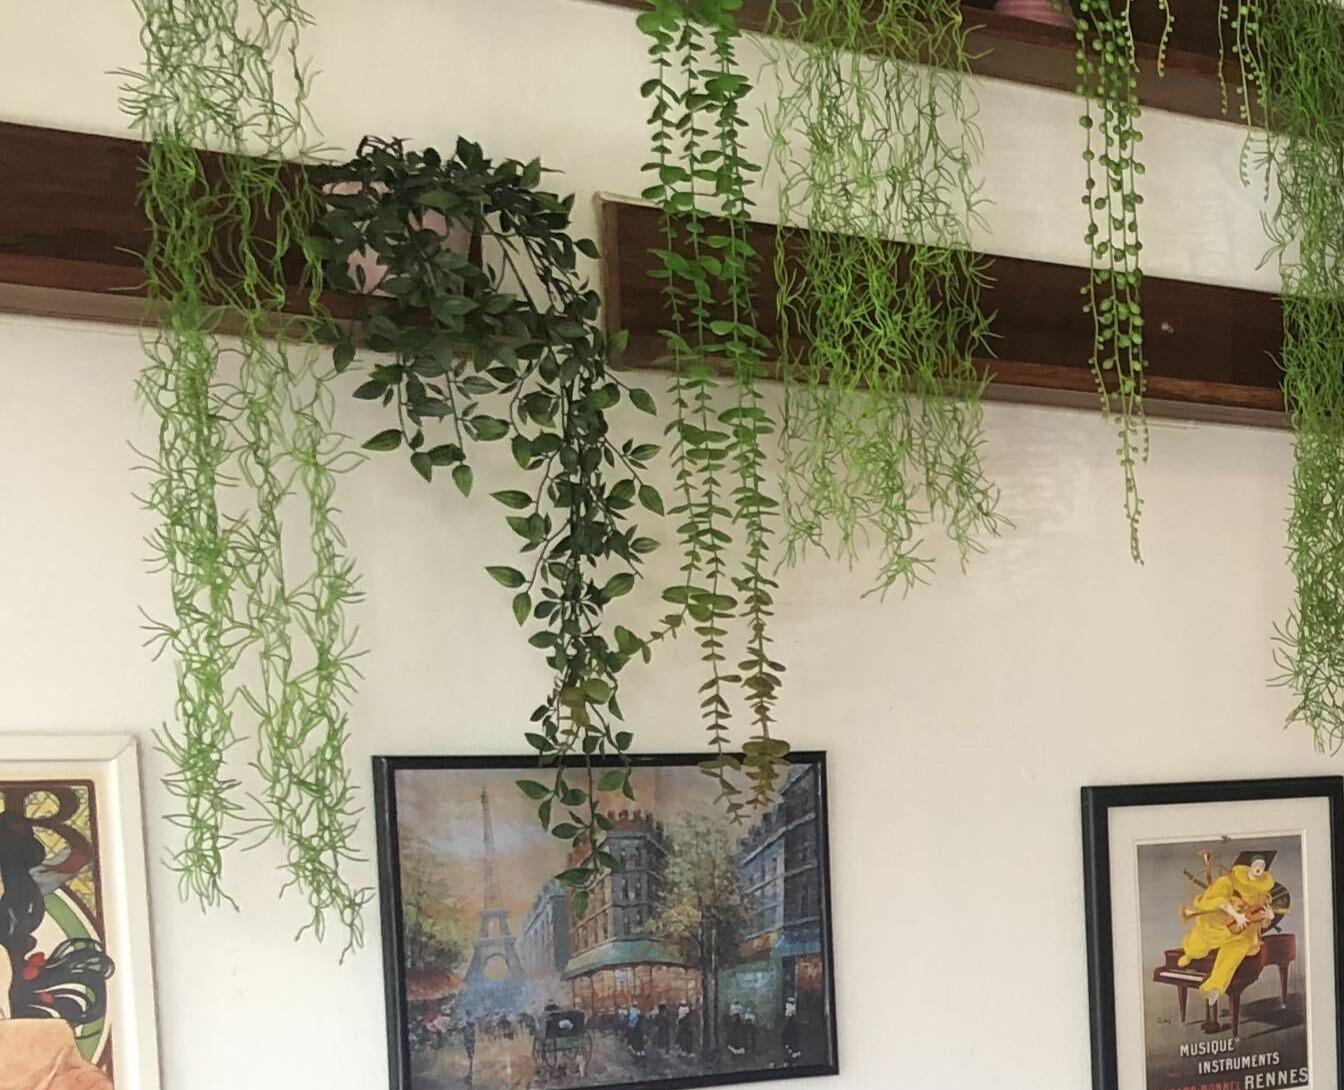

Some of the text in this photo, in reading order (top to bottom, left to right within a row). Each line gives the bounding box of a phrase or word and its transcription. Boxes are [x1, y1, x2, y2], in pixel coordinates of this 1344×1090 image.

[1180, 1038, 1234, 1057] MUSIQUE
[1198, 1052, 1280, 1075] INSTRUMENTS
[1245, 1068, 1308, 1090] RENNES
